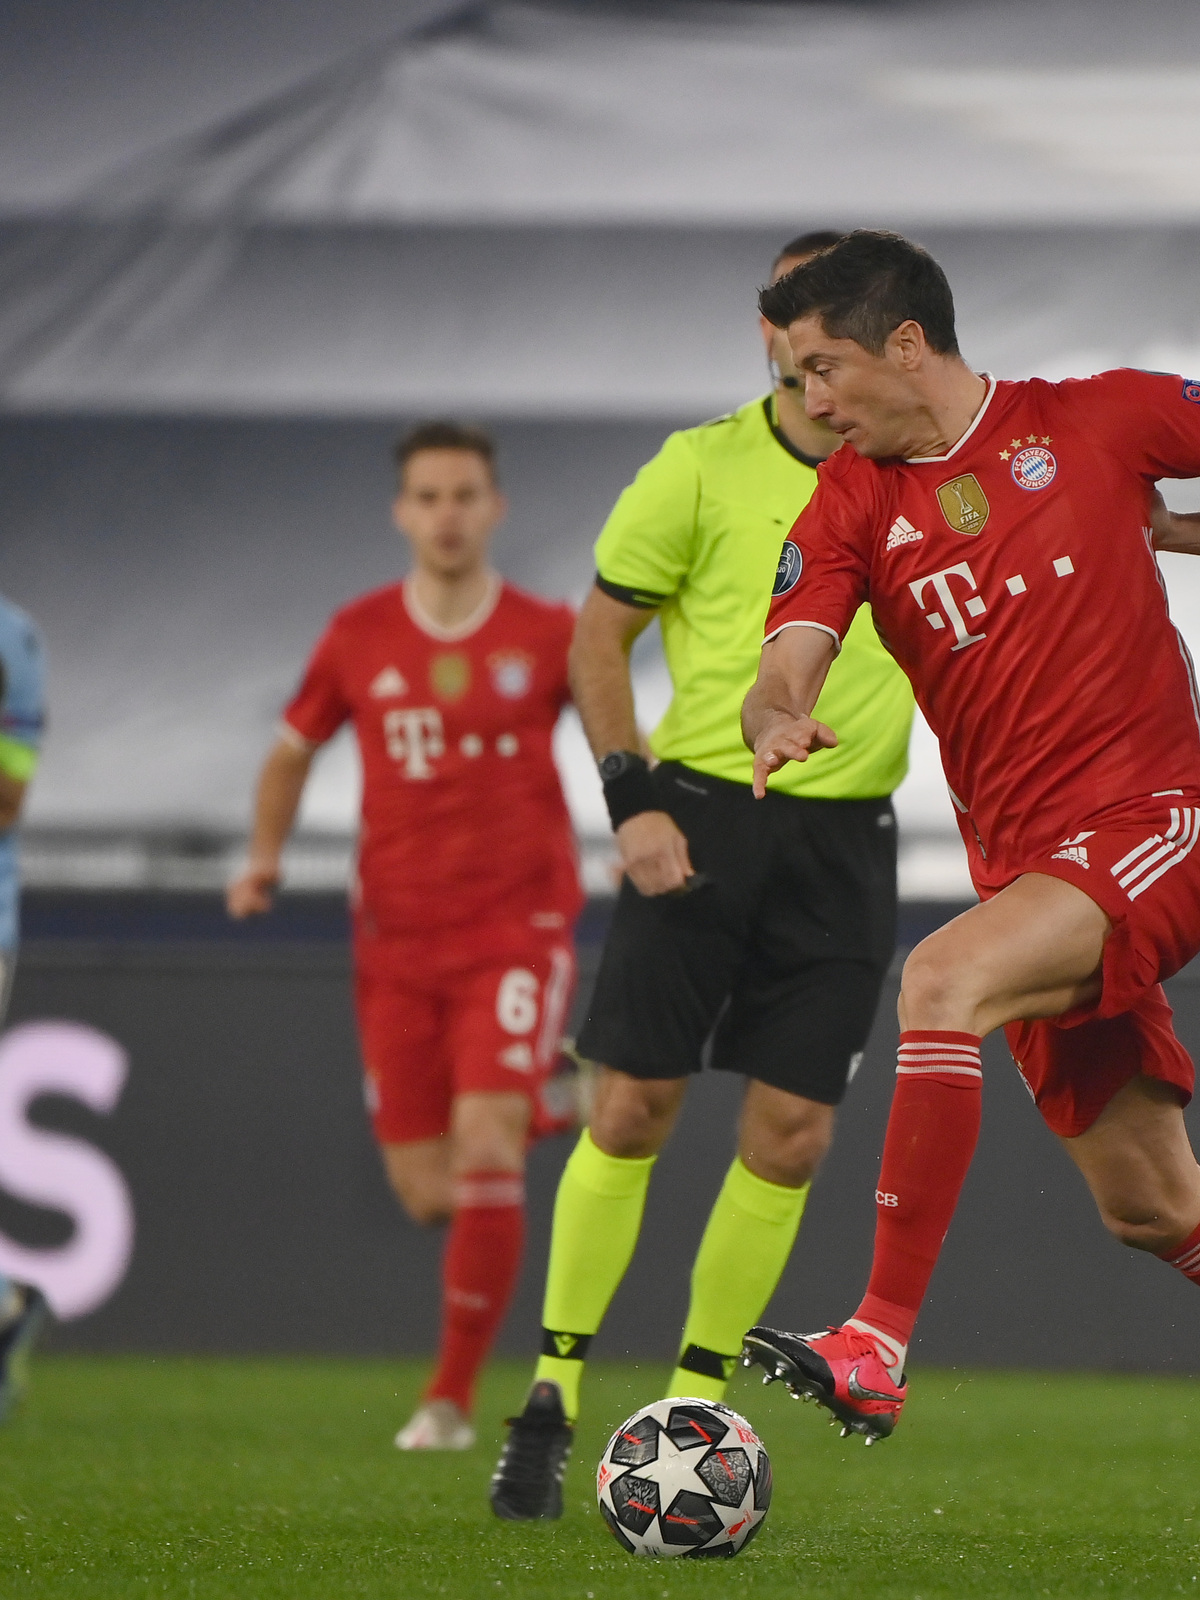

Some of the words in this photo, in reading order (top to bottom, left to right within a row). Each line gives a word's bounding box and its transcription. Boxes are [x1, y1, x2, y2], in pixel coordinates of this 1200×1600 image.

[1015, 460, 1022, 471] FC
[1019, 450, 1051, 461] BAYERN
[959, 511, 980, 524] FIFA
[886, 531, 924, 551] adidas
[1051, 853, 1090, 869] adidas
[496, 967, 538, 1035] 6
[875, 1189, 899, 1207] CB
